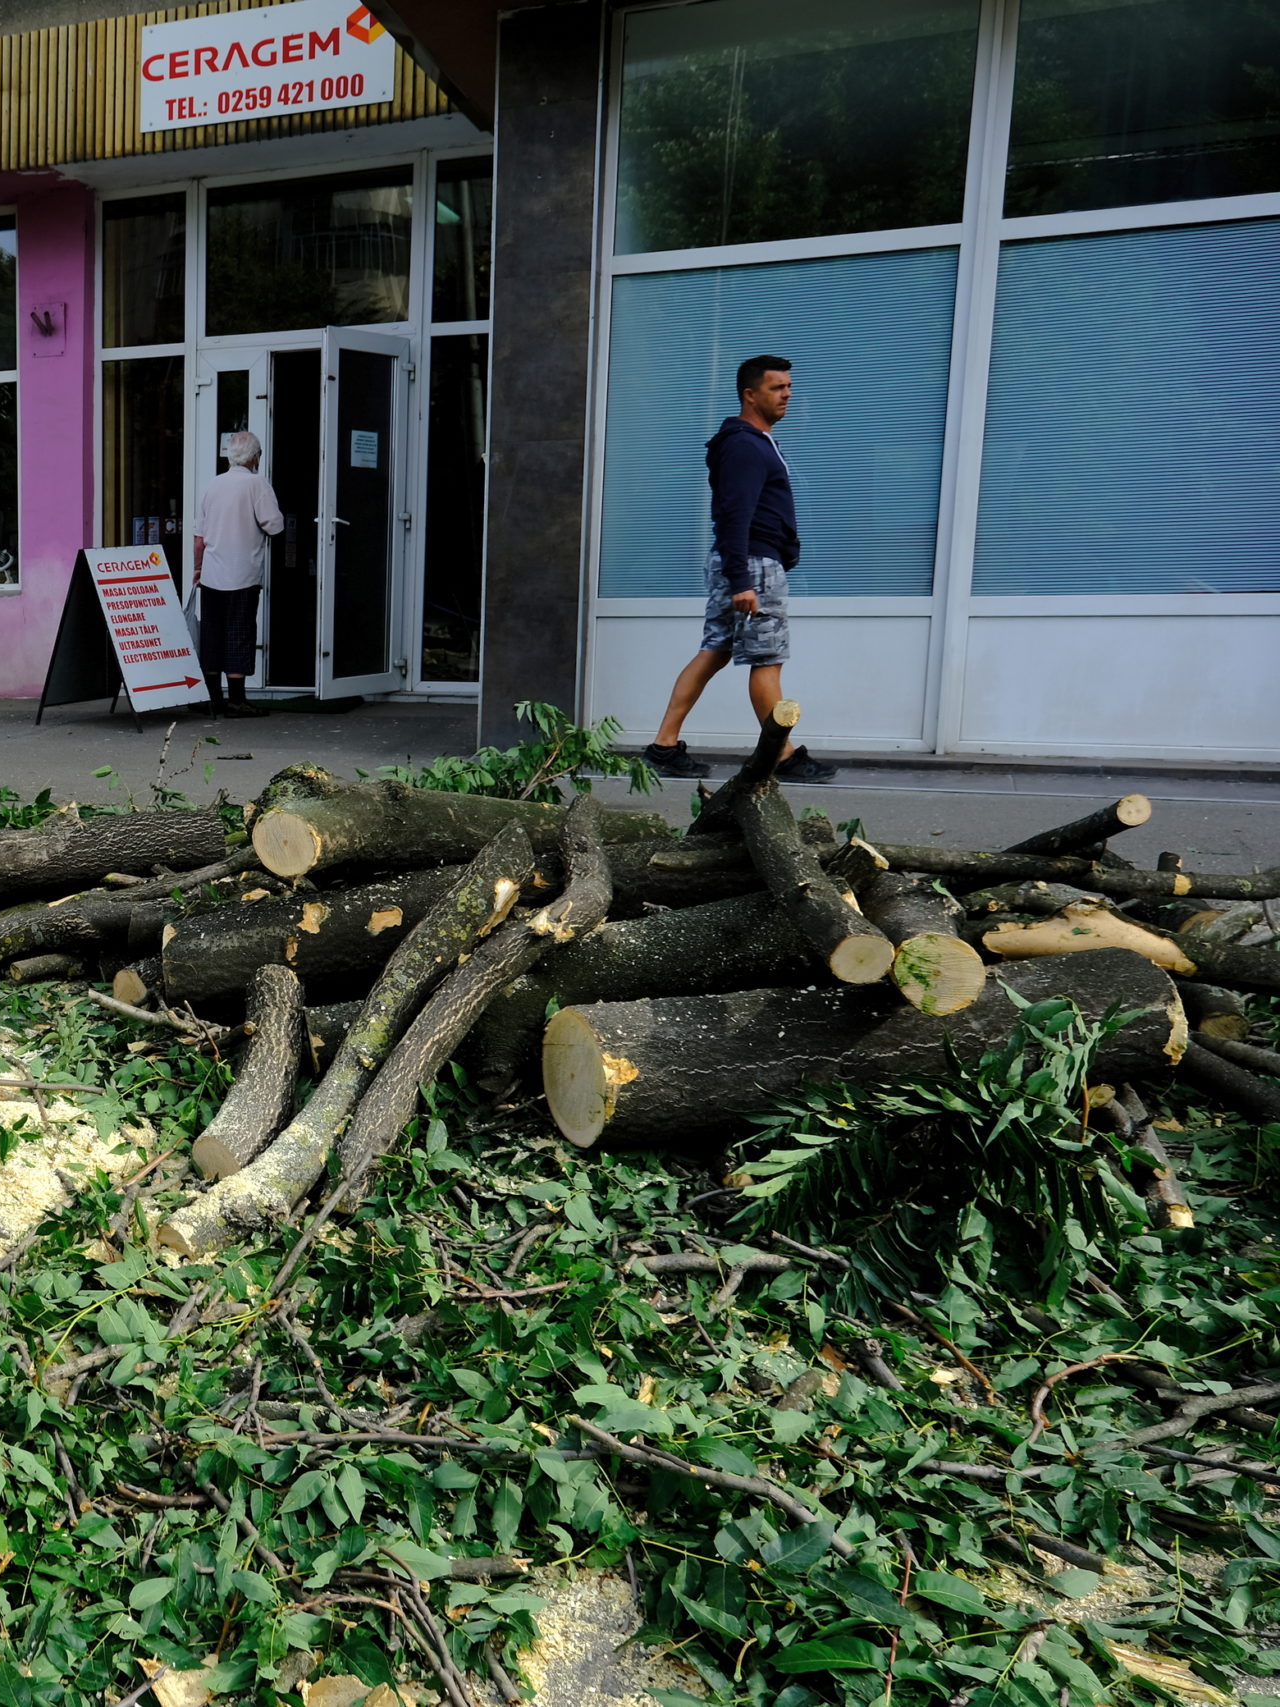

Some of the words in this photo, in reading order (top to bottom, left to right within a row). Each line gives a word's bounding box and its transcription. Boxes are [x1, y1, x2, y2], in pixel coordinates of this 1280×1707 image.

[142, 27, 340, 82] CERAGEM
[165, 96, 208, 121] TEL.:
[217, 86, 271, 115] 0259
[277, 80, 315, 106] 421
[321, 73, 364, 100] 000
[97, 559, 150, 573] CERAGEM
[102, 586, 126, 598] MASAJ
[110, 612, 146, 624] ELONGARE
[114, 627, 138, 638] MASAJ
[119, 638, 162, 651] ULTRASUNET
[123, 647, 191, 664] ELECTROSTIMULARE
